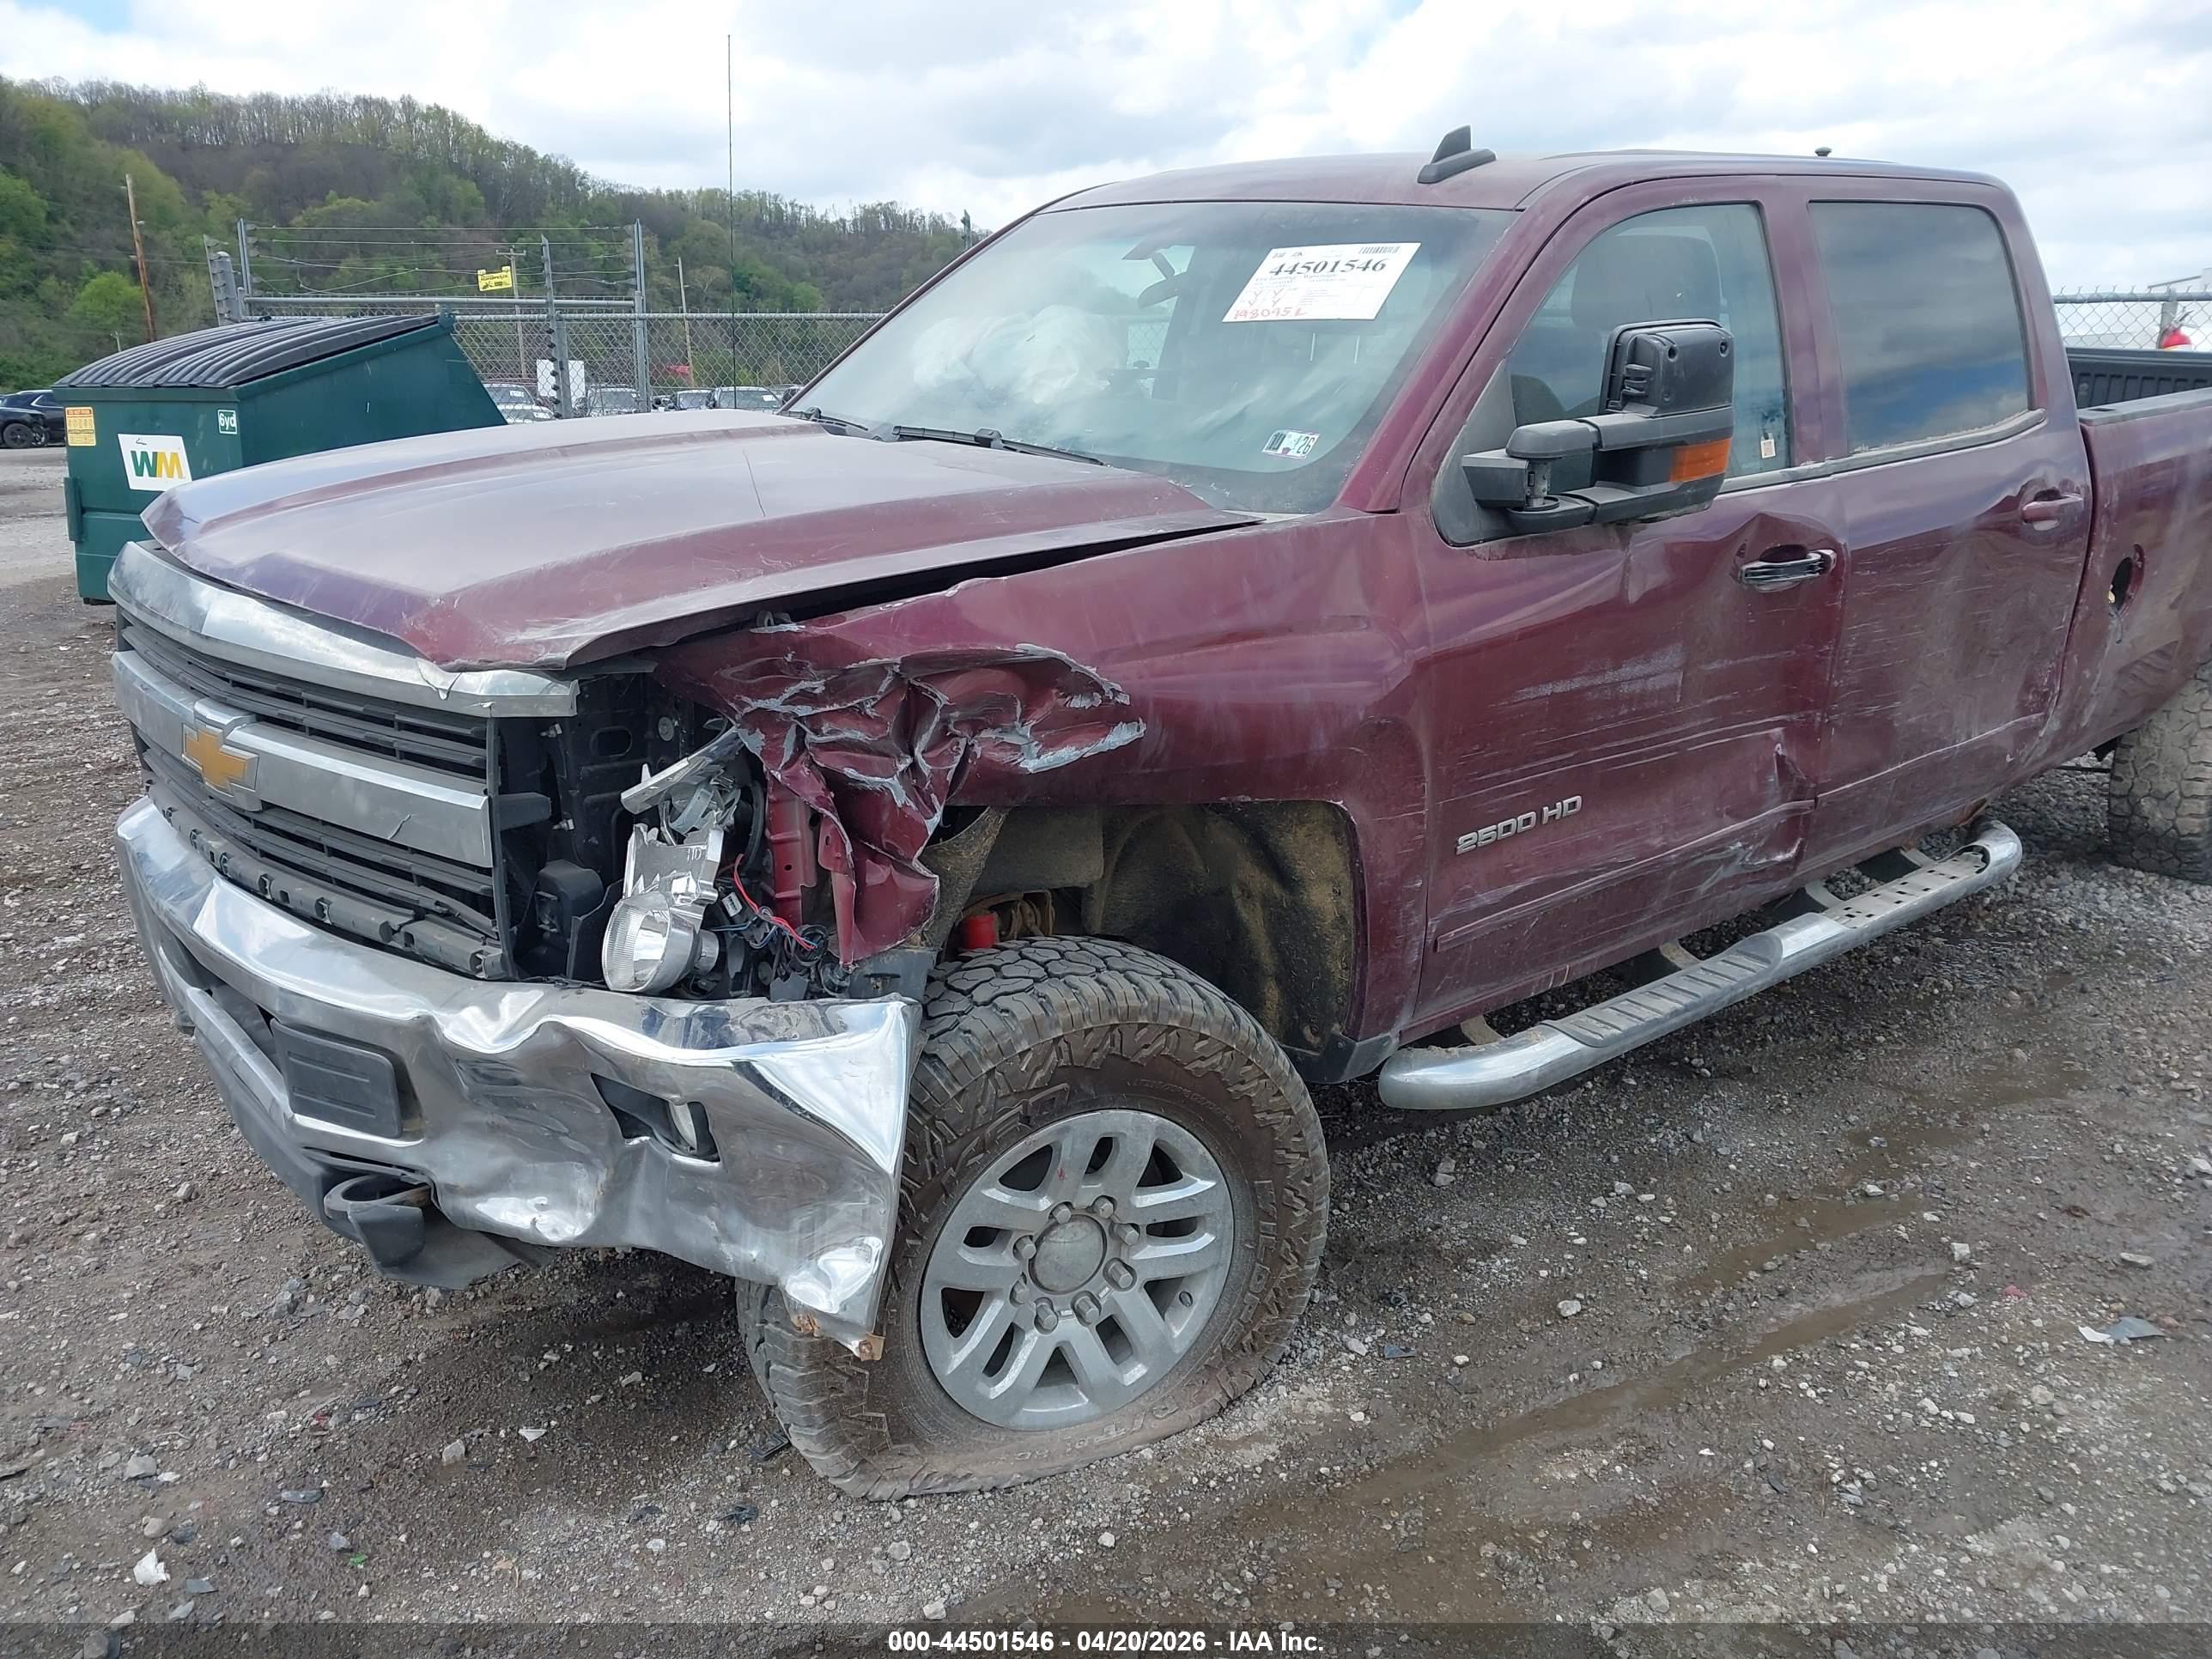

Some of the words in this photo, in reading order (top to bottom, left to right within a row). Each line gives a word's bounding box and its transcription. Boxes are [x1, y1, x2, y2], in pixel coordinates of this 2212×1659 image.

[1268, 258, 1391, 276] 44501546
[219, 412, 237, 430] 6yd
[130, 450, 183, 479] WM
[1455, 811, 1537, 855] 2500
[1541, 795, 1583, 825] HD
